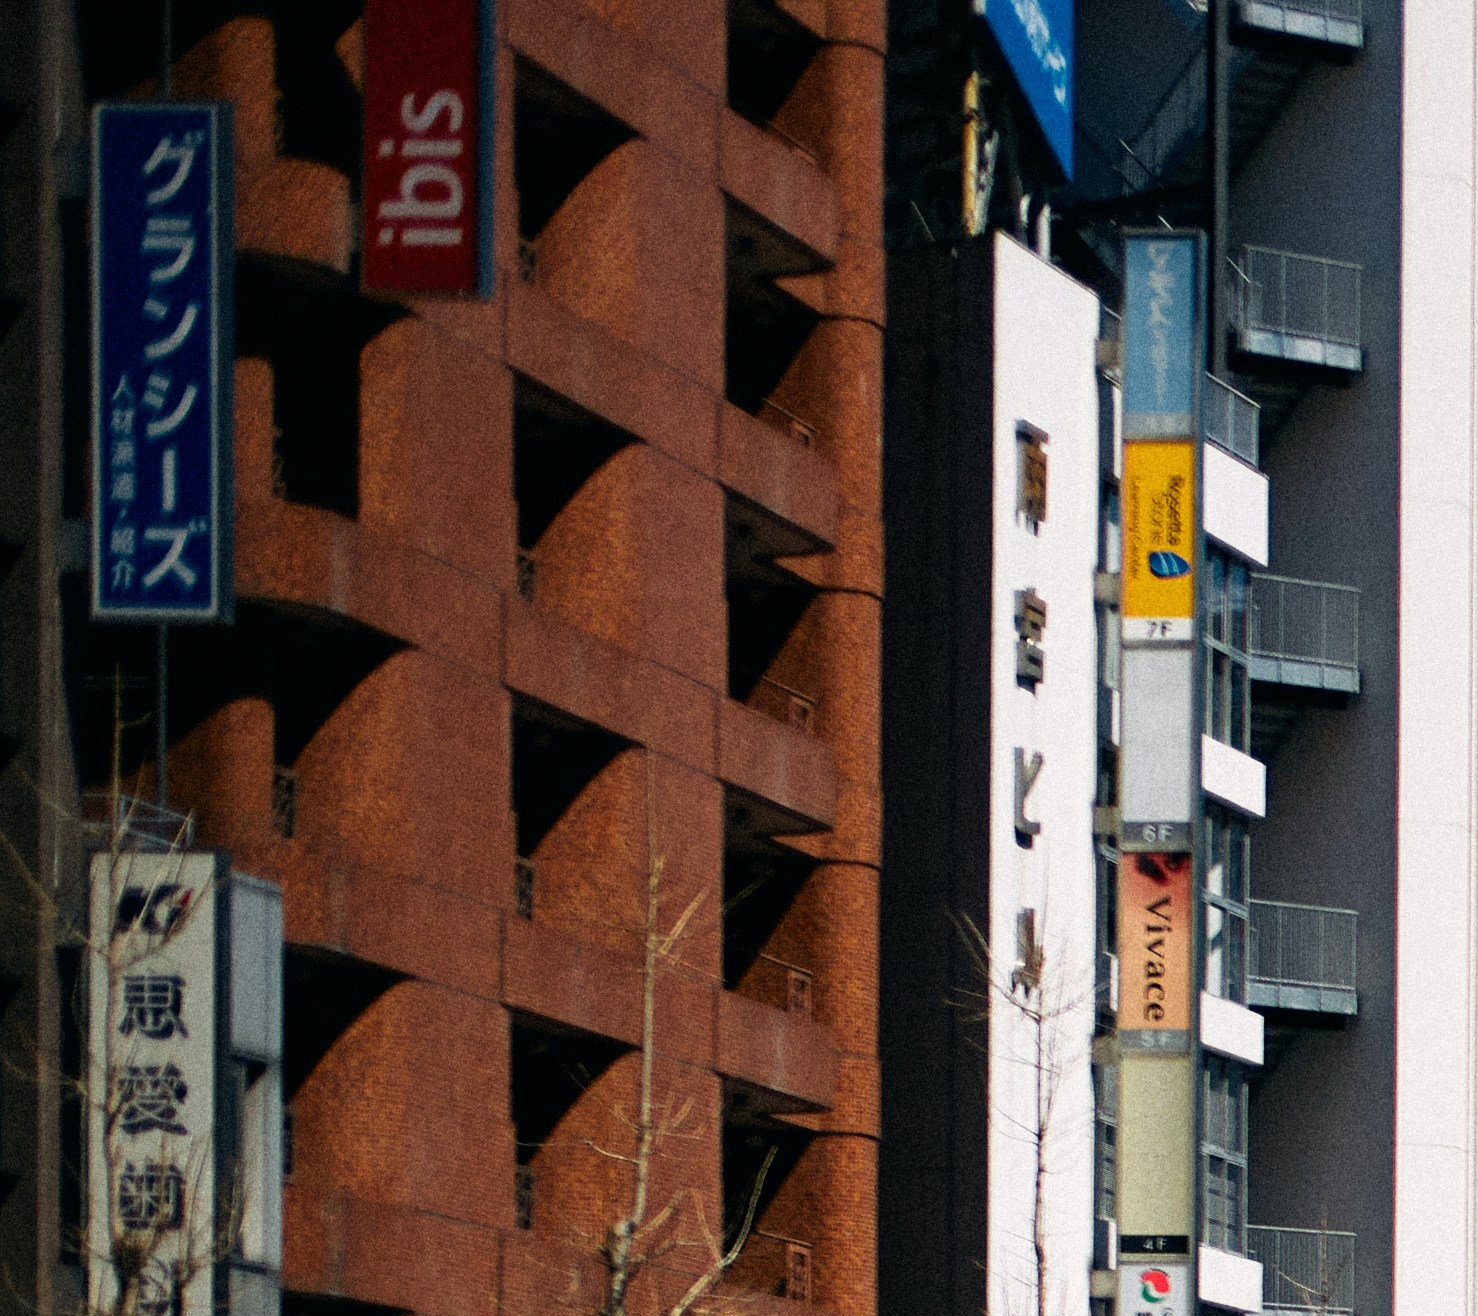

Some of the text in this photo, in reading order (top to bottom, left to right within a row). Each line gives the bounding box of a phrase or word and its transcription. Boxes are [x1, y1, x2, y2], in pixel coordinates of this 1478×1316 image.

[378, 88, 464, 247] ibis
[141, 129, 205, 590] グランシーズ
[1147, 621, 1173, 637] 7F
[1142, 825, 1173, 843] 6F
[1142, 895, 1172, 1022] Vivace
[1141, 1239, 1168, 1251] 4F
